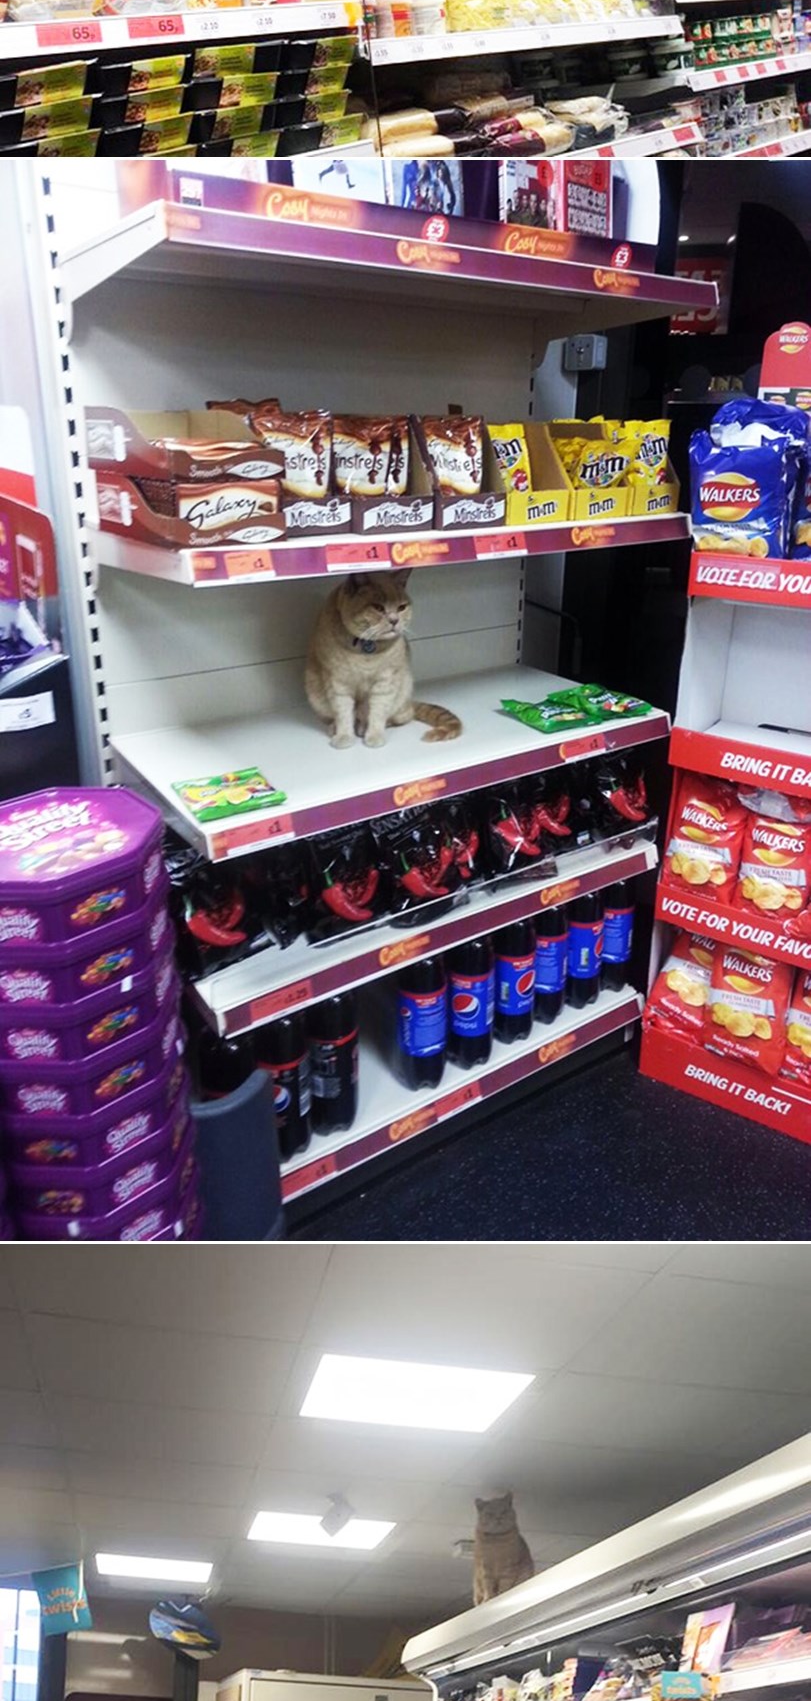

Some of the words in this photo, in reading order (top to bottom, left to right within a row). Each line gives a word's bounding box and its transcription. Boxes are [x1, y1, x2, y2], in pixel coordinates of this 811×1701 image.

[334, 452, 384, 471] instrels
[700, 486, 761, 504] WALKERS
[184, 496, 258, 530] Galaxy
[290, 509, 343, 526] Minstrels
[376, 509, 424, 526] Minstrels
[696, 565, 739, 585] VOTE
[739, 570, 777, 590] FOR
[720, 751, 773, 778] BRING
[771, 762, 793, 782] IT
[681, 805, 729, 832] WALKERS
[752, 828, 806, 854] WALKERS
[661, 897, 697, 922] VOTE
[700, 906, 729, 933] FOR
[731, 920, 775, 948] YOUR
[722, 954, 775, 983] WALKERS
[684, 1063, 729, 1092] BRING
[728, 1080, 746, 1097] IT
[743, 1086, 793, 1116] BACK!
